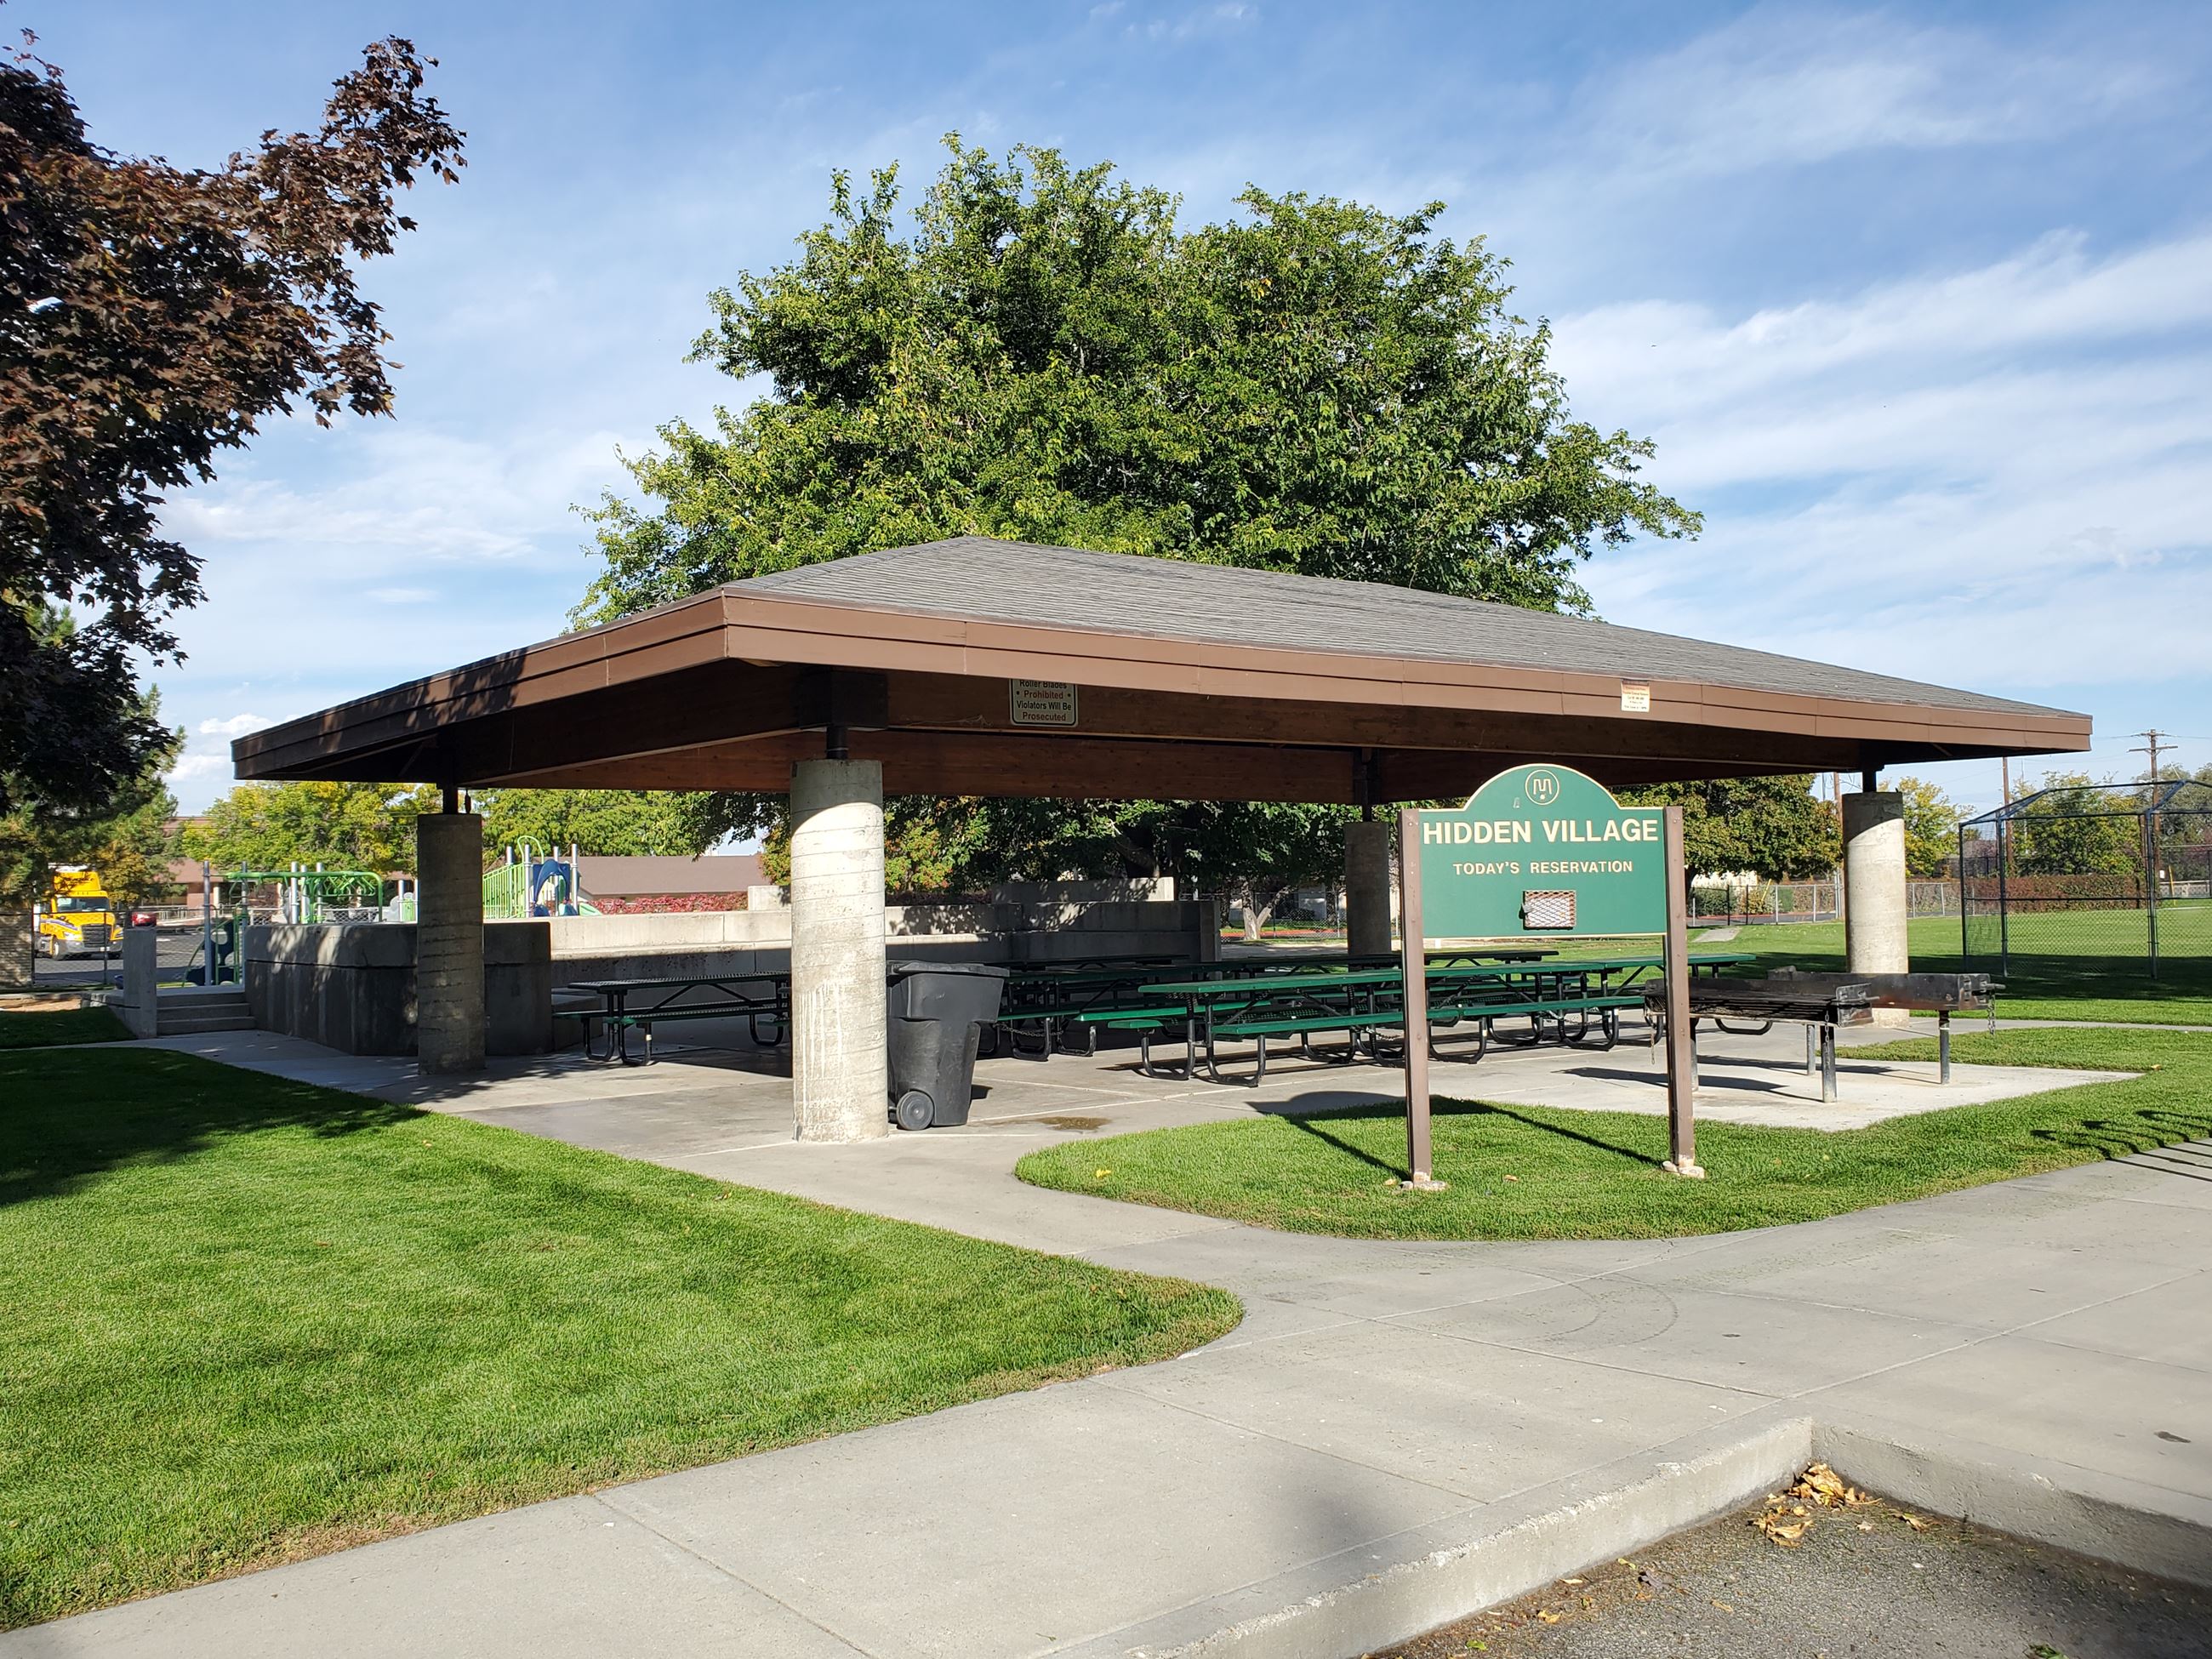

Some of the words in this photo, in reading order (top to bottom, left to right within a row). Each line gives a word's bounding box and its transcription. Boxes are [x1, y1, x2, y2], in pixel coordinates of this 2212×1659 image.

[1019, 680, 1040, 688] Roller
[1023, 690, 1063, 699] Prohibited
[1016, 700, 1047, 710] Violators
[1048, 702, 1061, 710] Will
[1063, 703, 1072, 711] Be
[1023, 711, 1066, 721] Prosecuted
[1422, 820, 1531, 845] HIDDEN
[1542, 818, 1659, 843] VILLAGE
[1453, 861, 1520, 875] TODAY'S
[1530, 860, 1633, 874] RESERVATION
